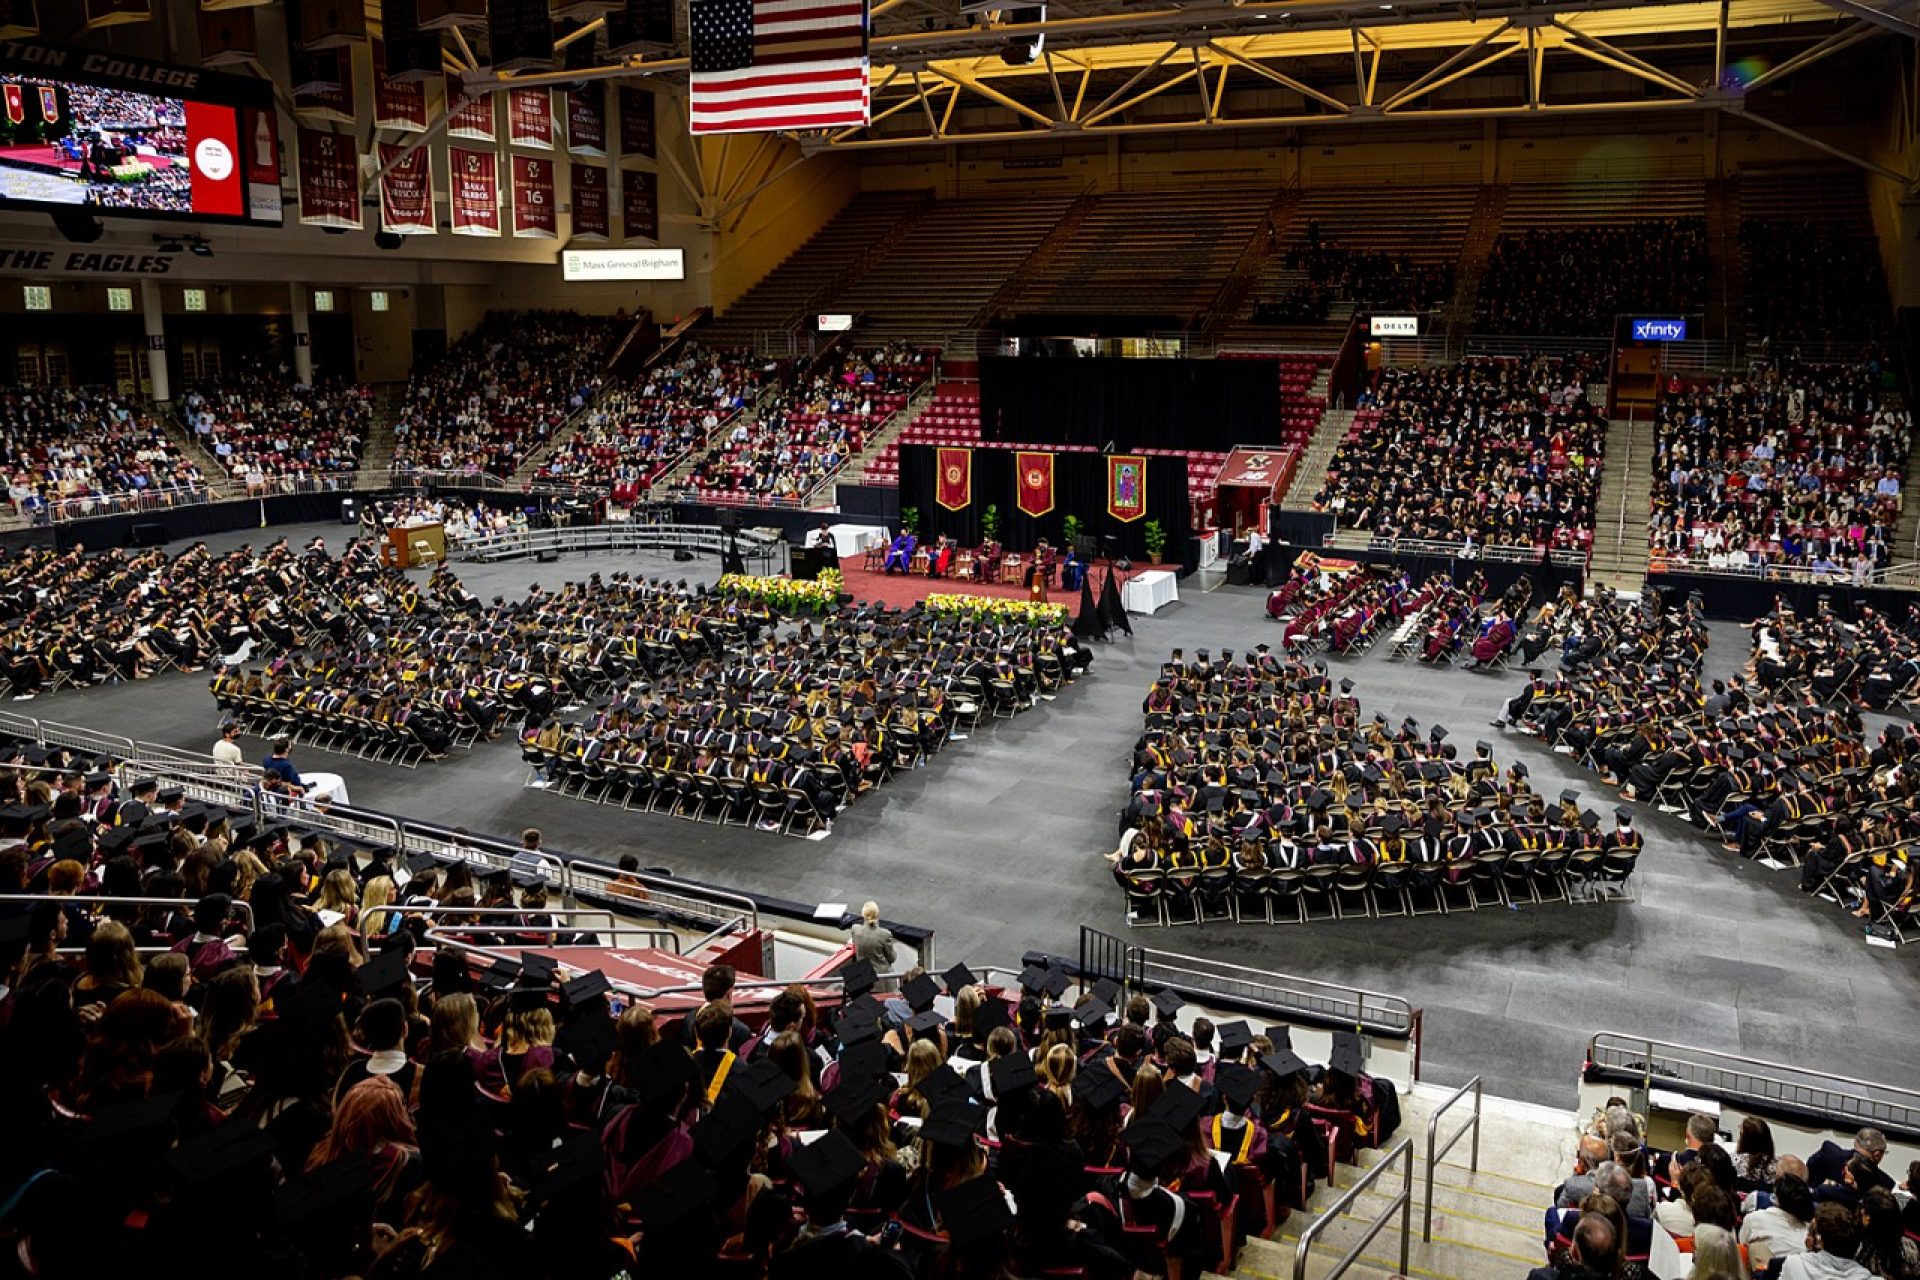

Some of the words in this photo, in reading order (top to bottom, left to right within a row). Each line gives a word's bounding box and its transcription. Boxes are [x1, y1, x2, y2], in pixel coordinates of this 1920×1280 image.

[81, 53, 201, 90] COLLEGE
[524, 190, 544, 205] 16
[0, 249, 54, 270] THE
[64, 252, 173, 274] EAGLES
[582, 260, 606, 270] Mass
[606, 259, 641, 270] General
[641, 258, 679, 270] Brigham
[1383, 323, 1415, 331] DELTA
[1636, 322, 1682, 339] xfinity
